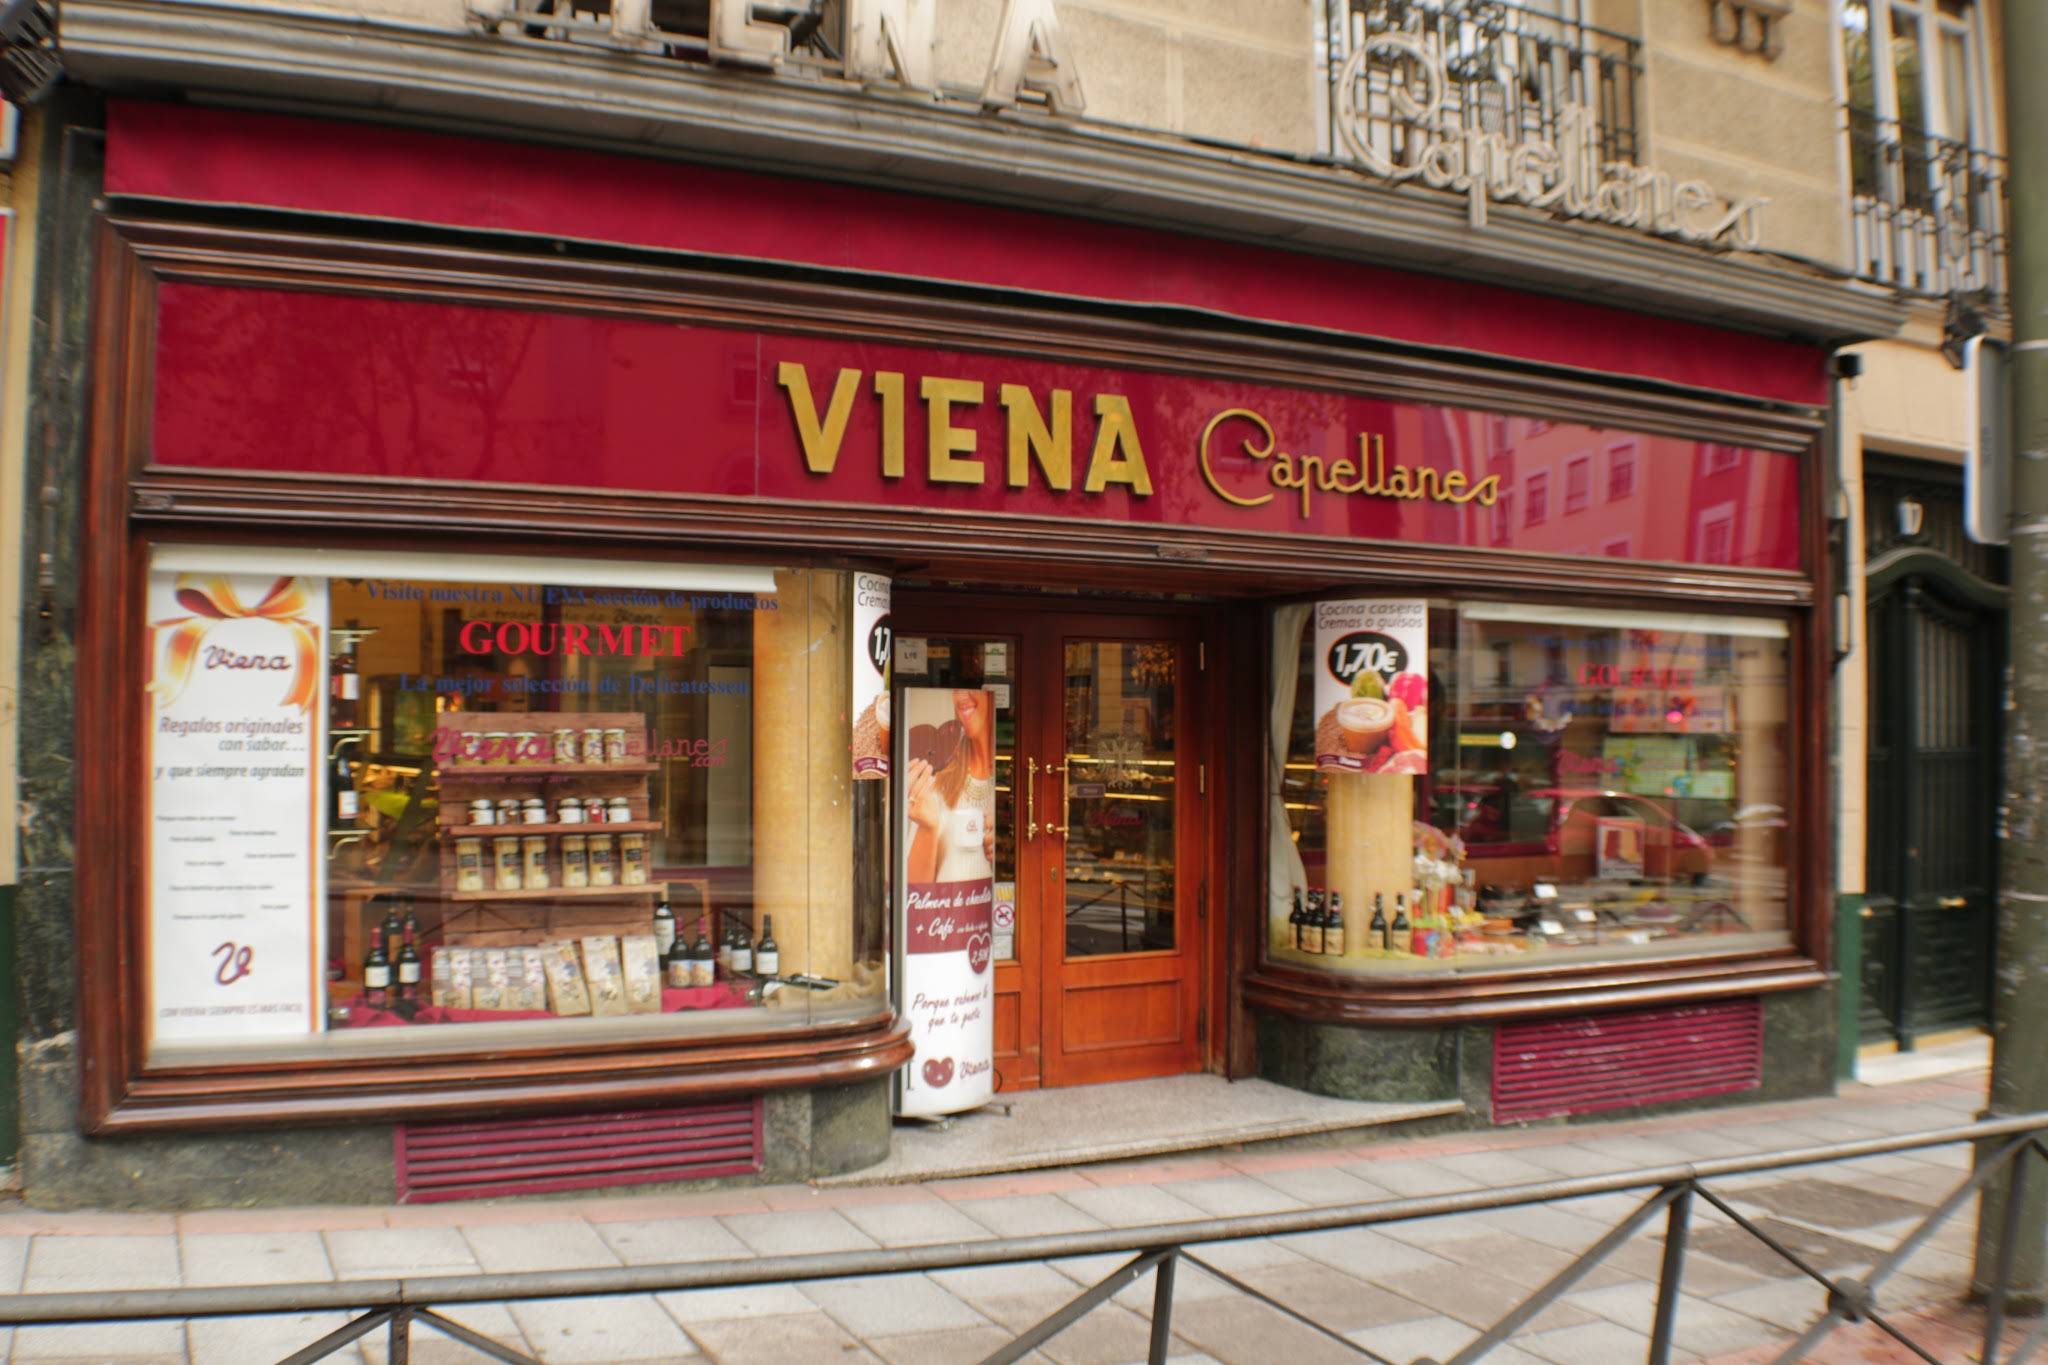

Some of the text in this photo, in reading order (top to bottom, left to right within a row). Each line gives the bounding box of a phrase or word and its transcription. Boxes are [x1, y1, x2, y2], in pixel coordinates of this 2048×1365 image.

[1335, 31, 1771, 249] Capellanes
[778, 361, 1154, 496] VIENA
[1200, 407, 1500, 519] Capellanes
[367, 582, 423, 600] Visite
[431, 583, 504, 602] nuestra
[664, 591, 685, 609] de
[689, 593, 779, 615] productos
[1318, 602, 1423, 617] Cocina casera
[1318, 616, 1423, 631] Cremas o guisos
[459, 620, 693, 657] GOURMET
[203, 646, 291, 671] Viena
[1334, 642, 1399, 678] 1,70€
[401, 672, 429, 692] La
[436, 673, 496, 696] mejor
[501, 674, 592, 694] selección
[597, 675, 621, 693] de
[158, 716, 304, 738] Regalos originales
[218, 739, 245, 753] con
[154, 764, 304, 781] y que siempre agradan
[928, 916, 956, 941] Café
